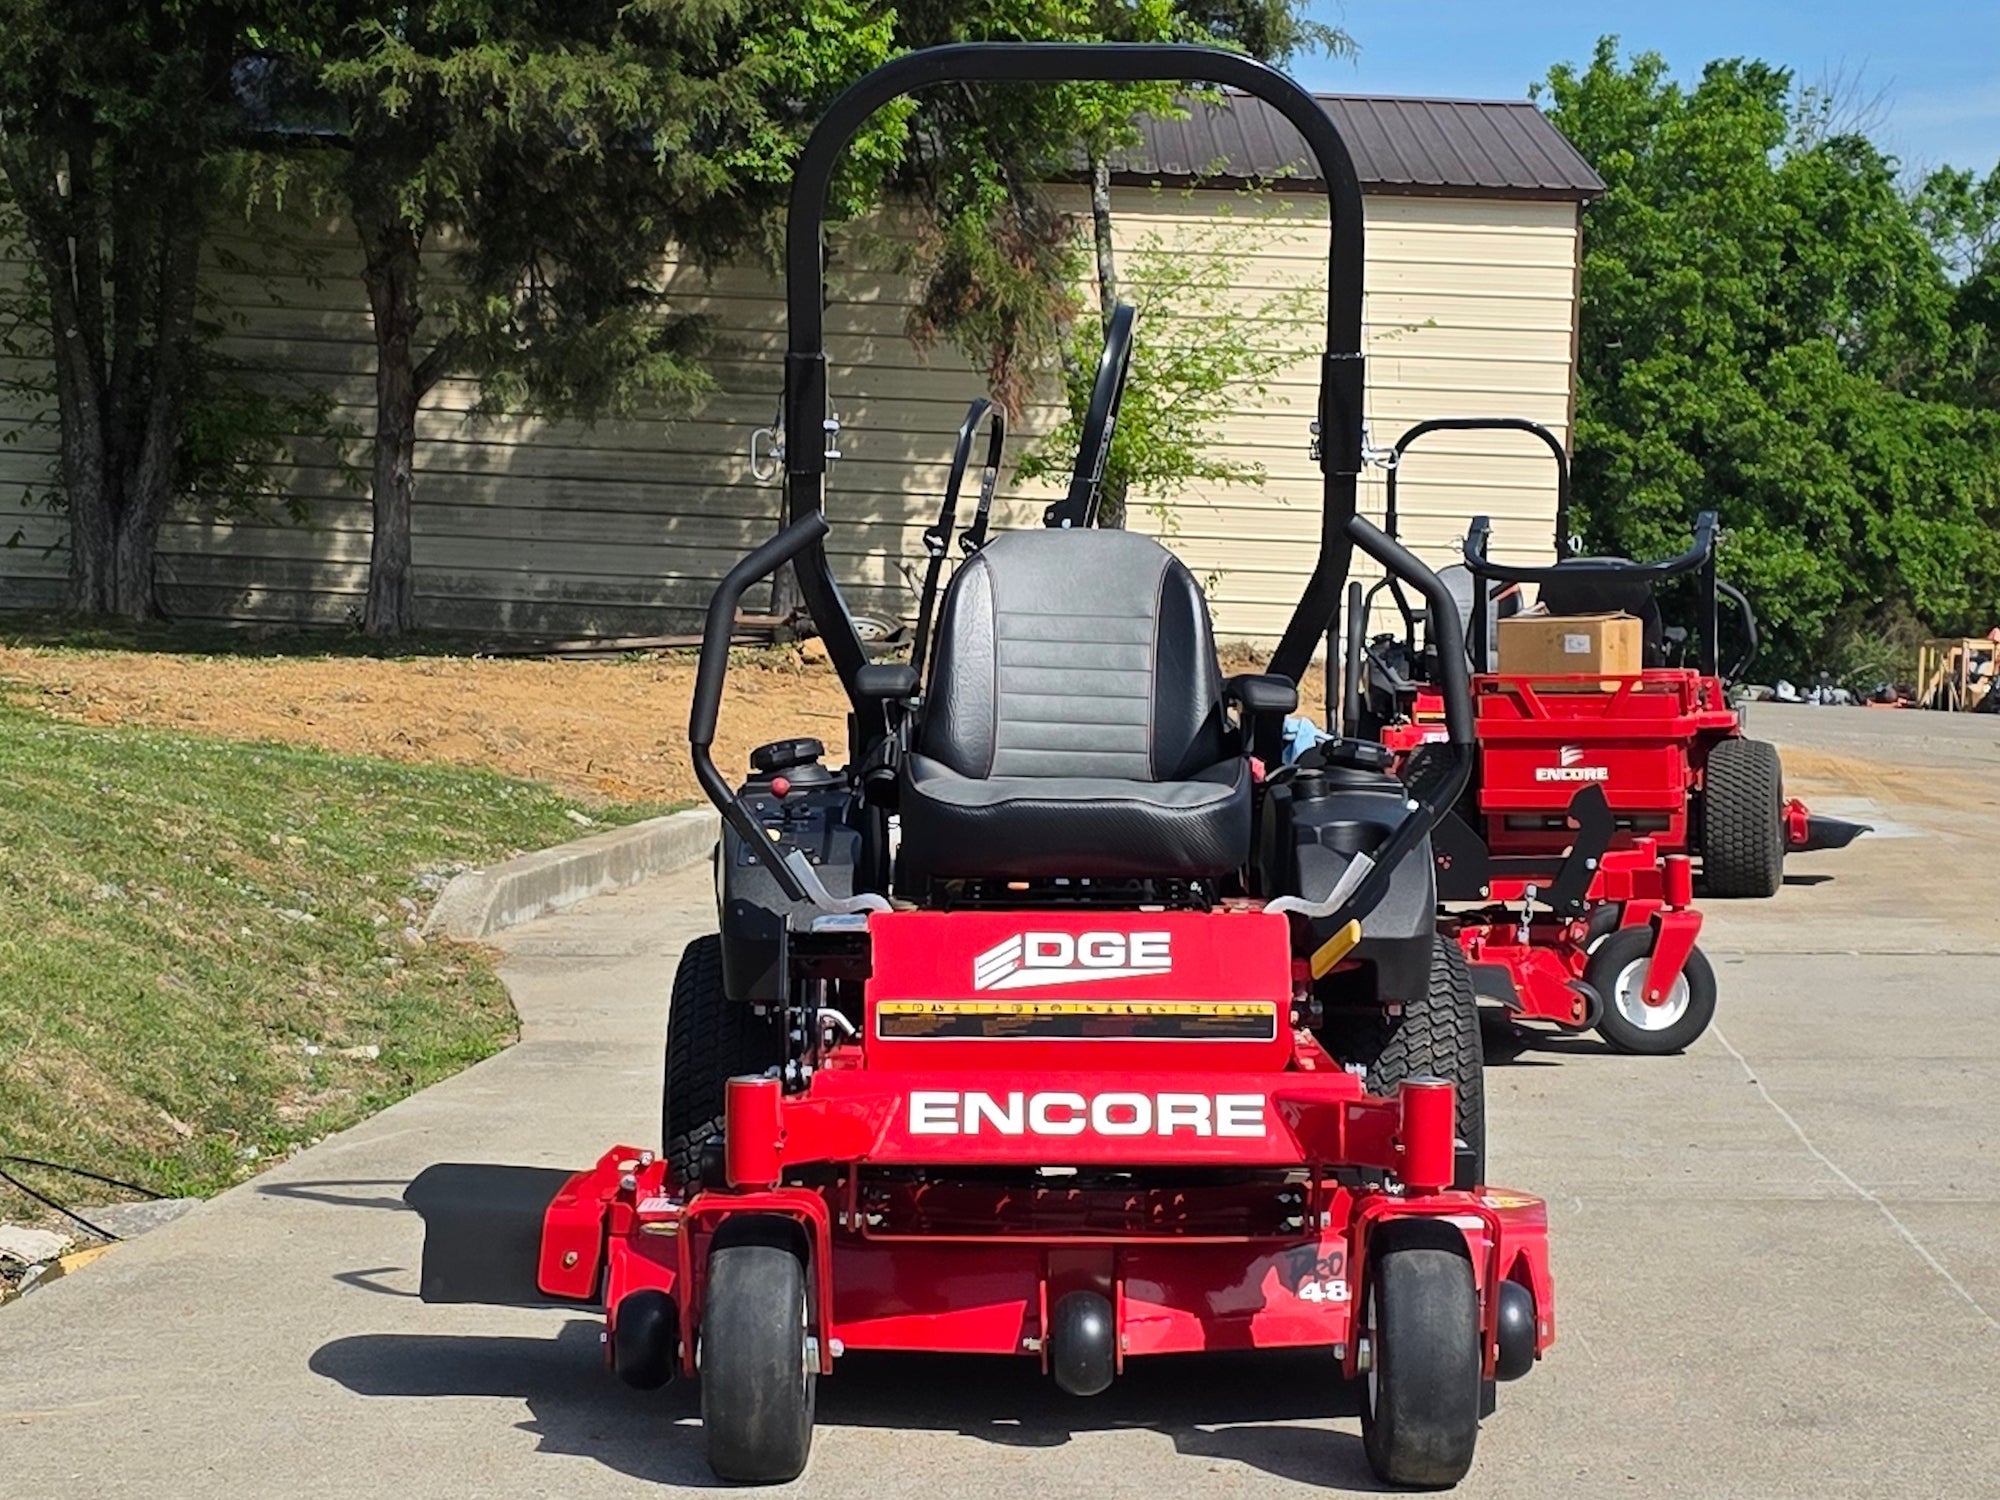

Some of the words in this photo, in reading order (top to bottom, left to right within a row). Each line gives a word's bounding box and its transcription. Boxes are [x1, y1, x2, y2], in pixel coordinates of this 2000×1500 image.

[1535, 767, 1609, 781] ENCORE
[908, 1091, 1267, 1137] ENCORE
[1298, 1279, 1352, 1303] 48
